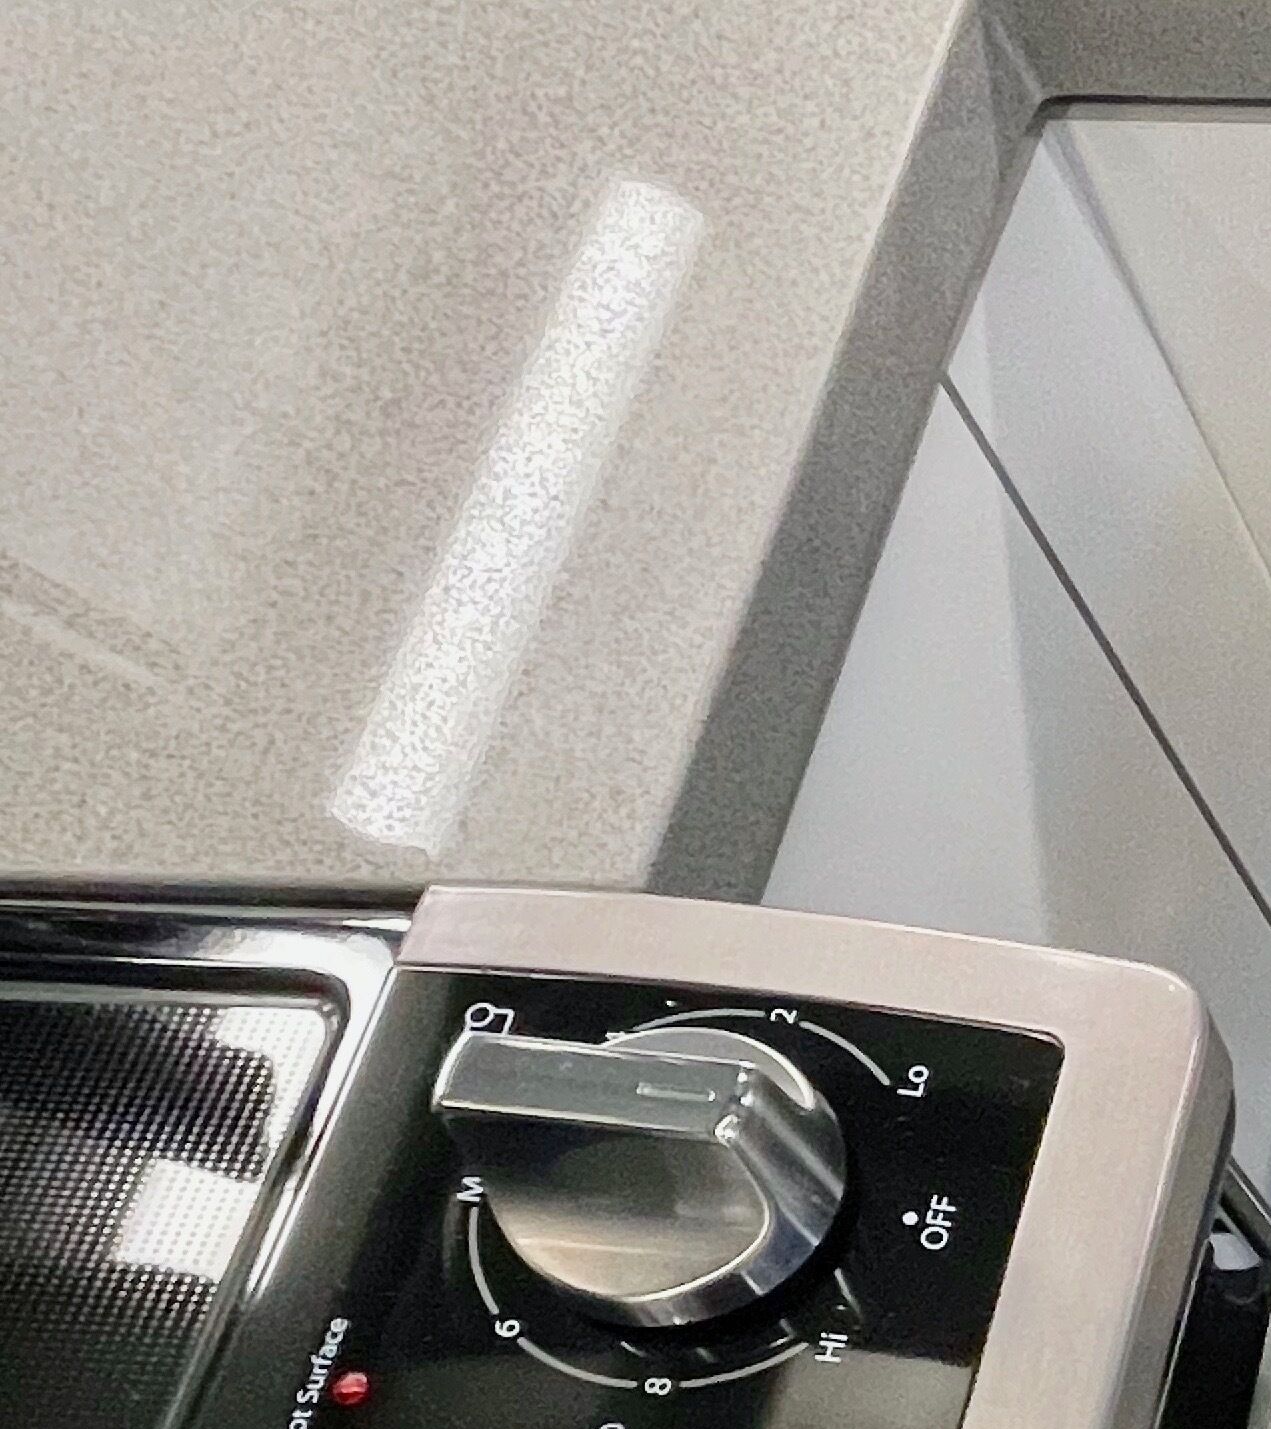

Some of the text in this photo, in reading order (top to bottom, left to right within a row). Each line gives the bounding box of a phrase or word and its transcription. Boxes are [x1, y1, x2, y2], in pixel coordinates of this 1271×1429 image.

[769, 1008, 798, 1024] 2
[896, 1065, 930, 1098] Lo
[920, 1195, 958, 1250] OFF
[494, 1319, 521, 1338] 6
[297, 1318, 349, 1404] Surface
[815, 1331, 849, 1364] Hi
[644, 1377, 672, 1396] 8
